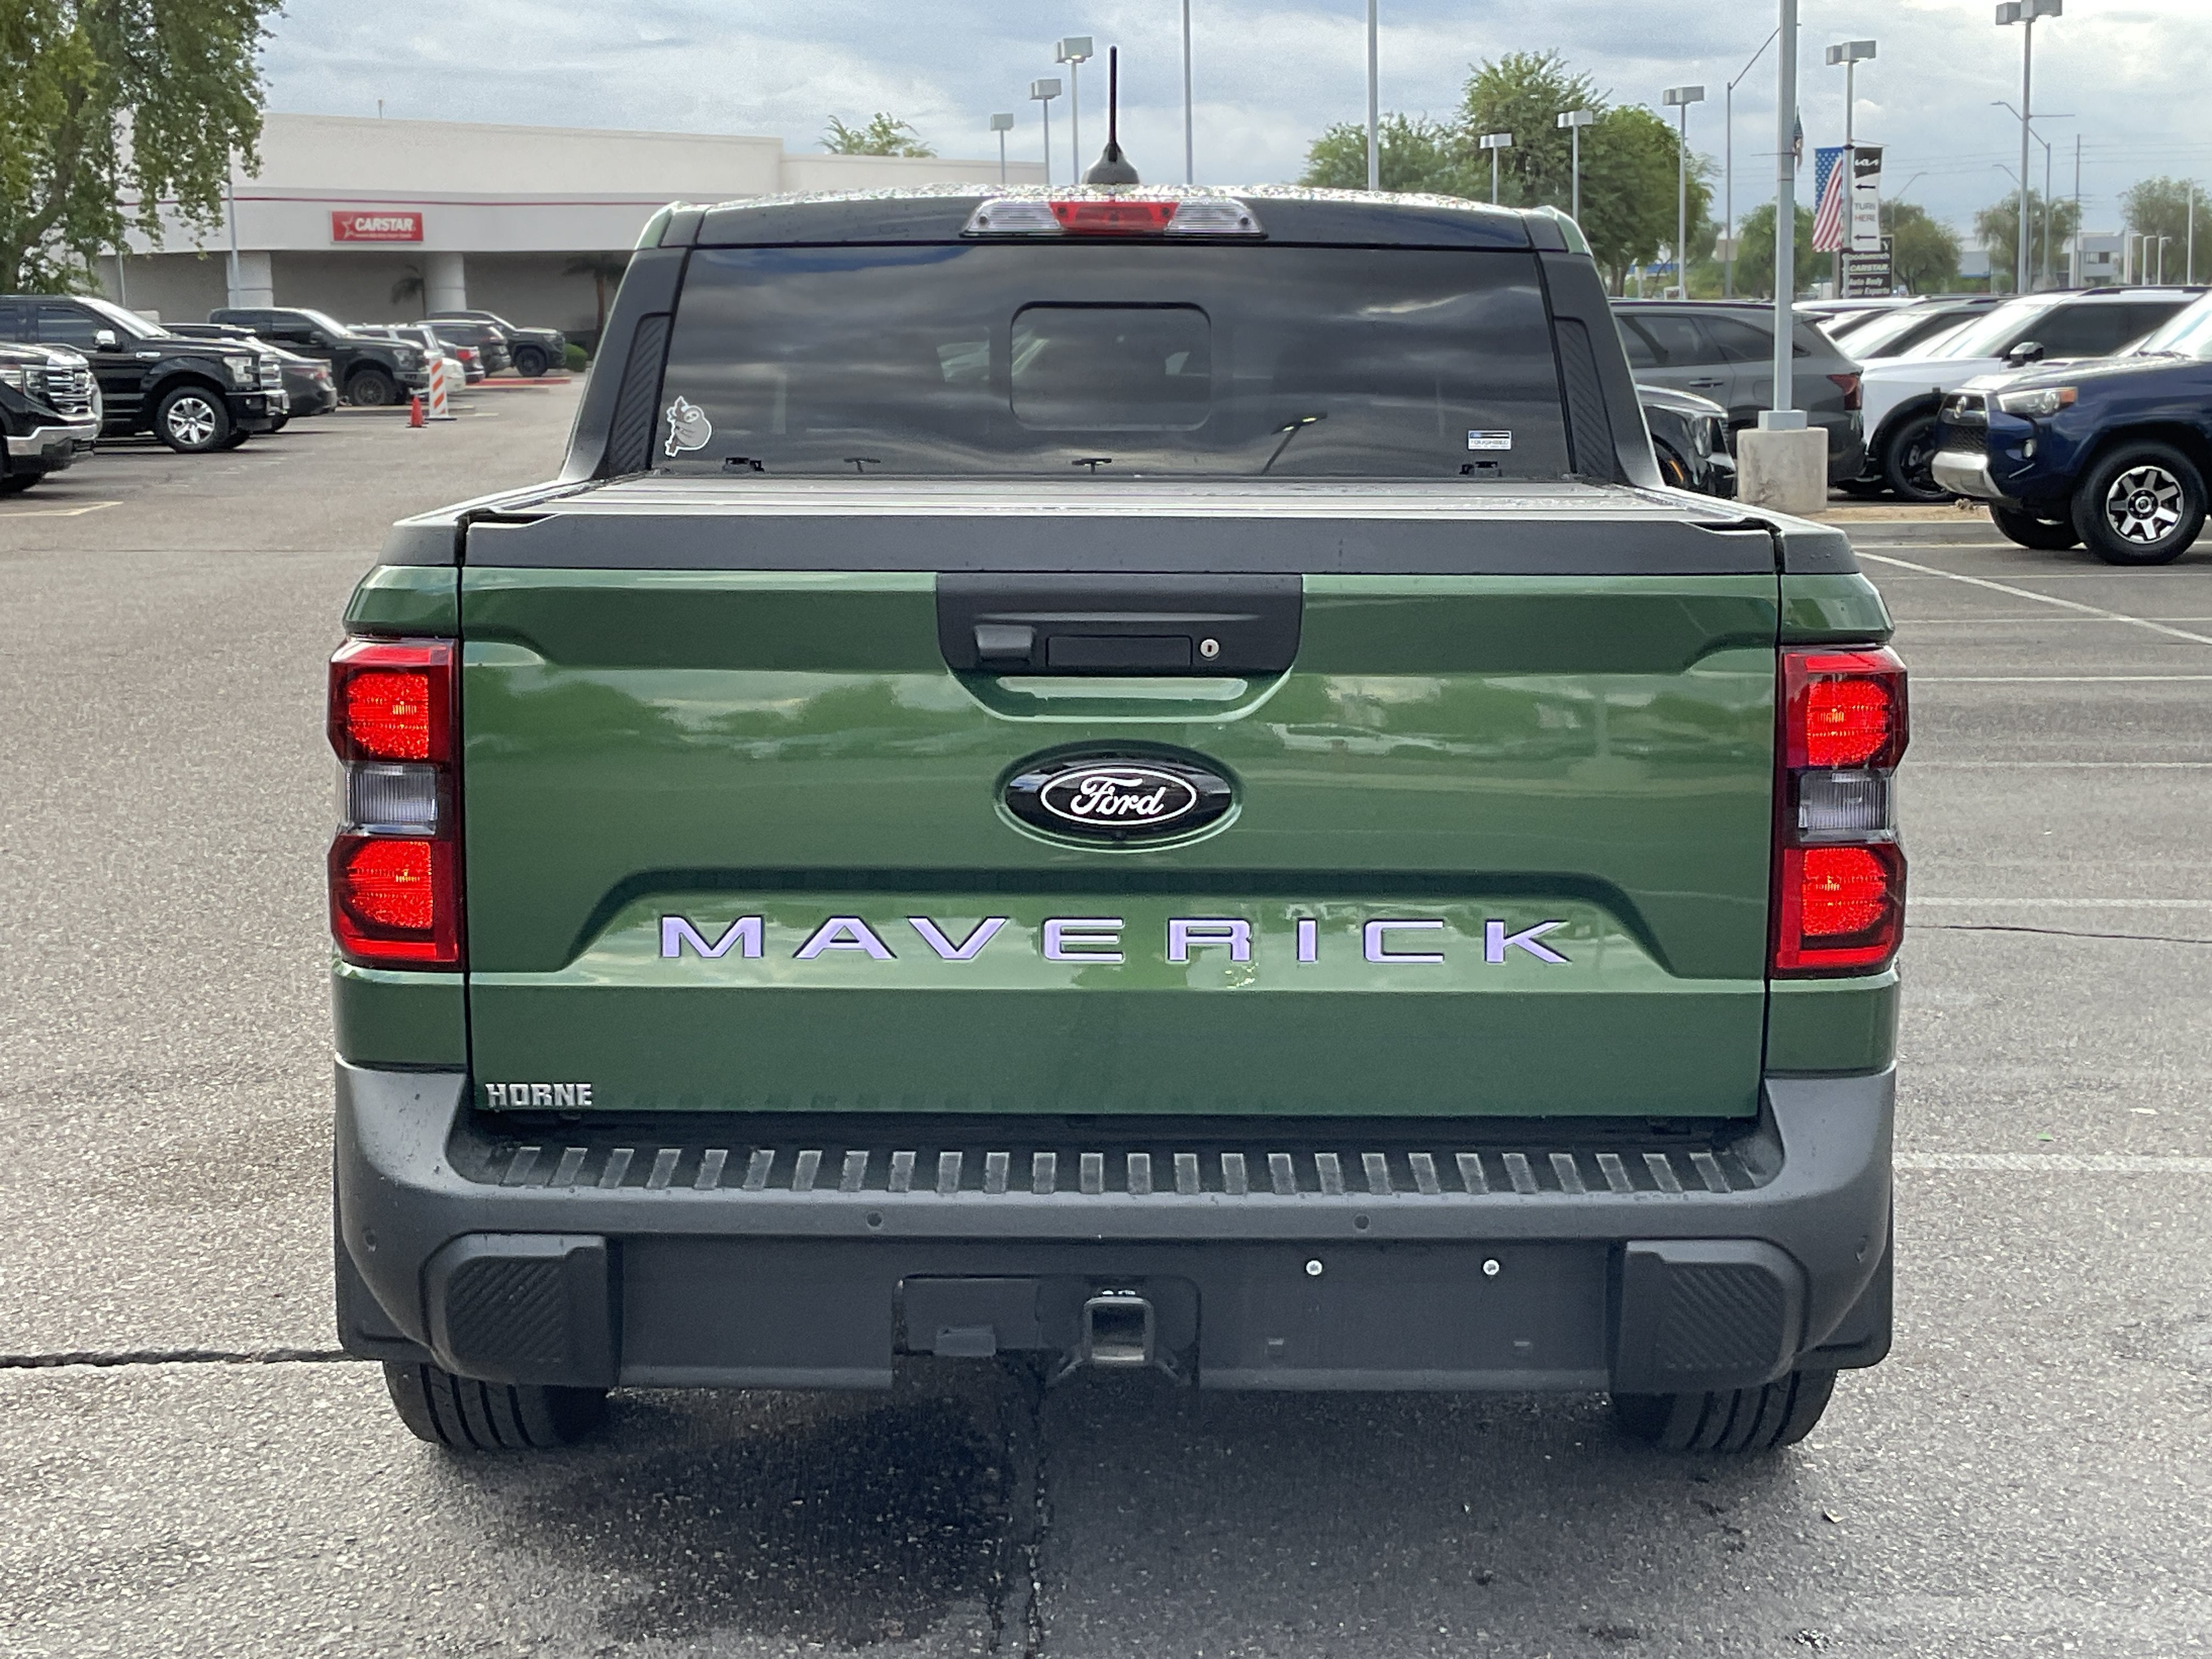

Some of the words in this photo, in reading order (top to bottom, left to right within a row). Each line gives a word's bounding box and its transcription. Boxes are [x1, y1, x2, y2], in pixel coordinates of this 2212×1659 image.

[355, 218, 413, 232] CARSTAR
[1070, 776, 1166, 815] Ford
[661, 915, 1571, 964] MAVERICK
[485, 1083, 592, 1107] HORNE
